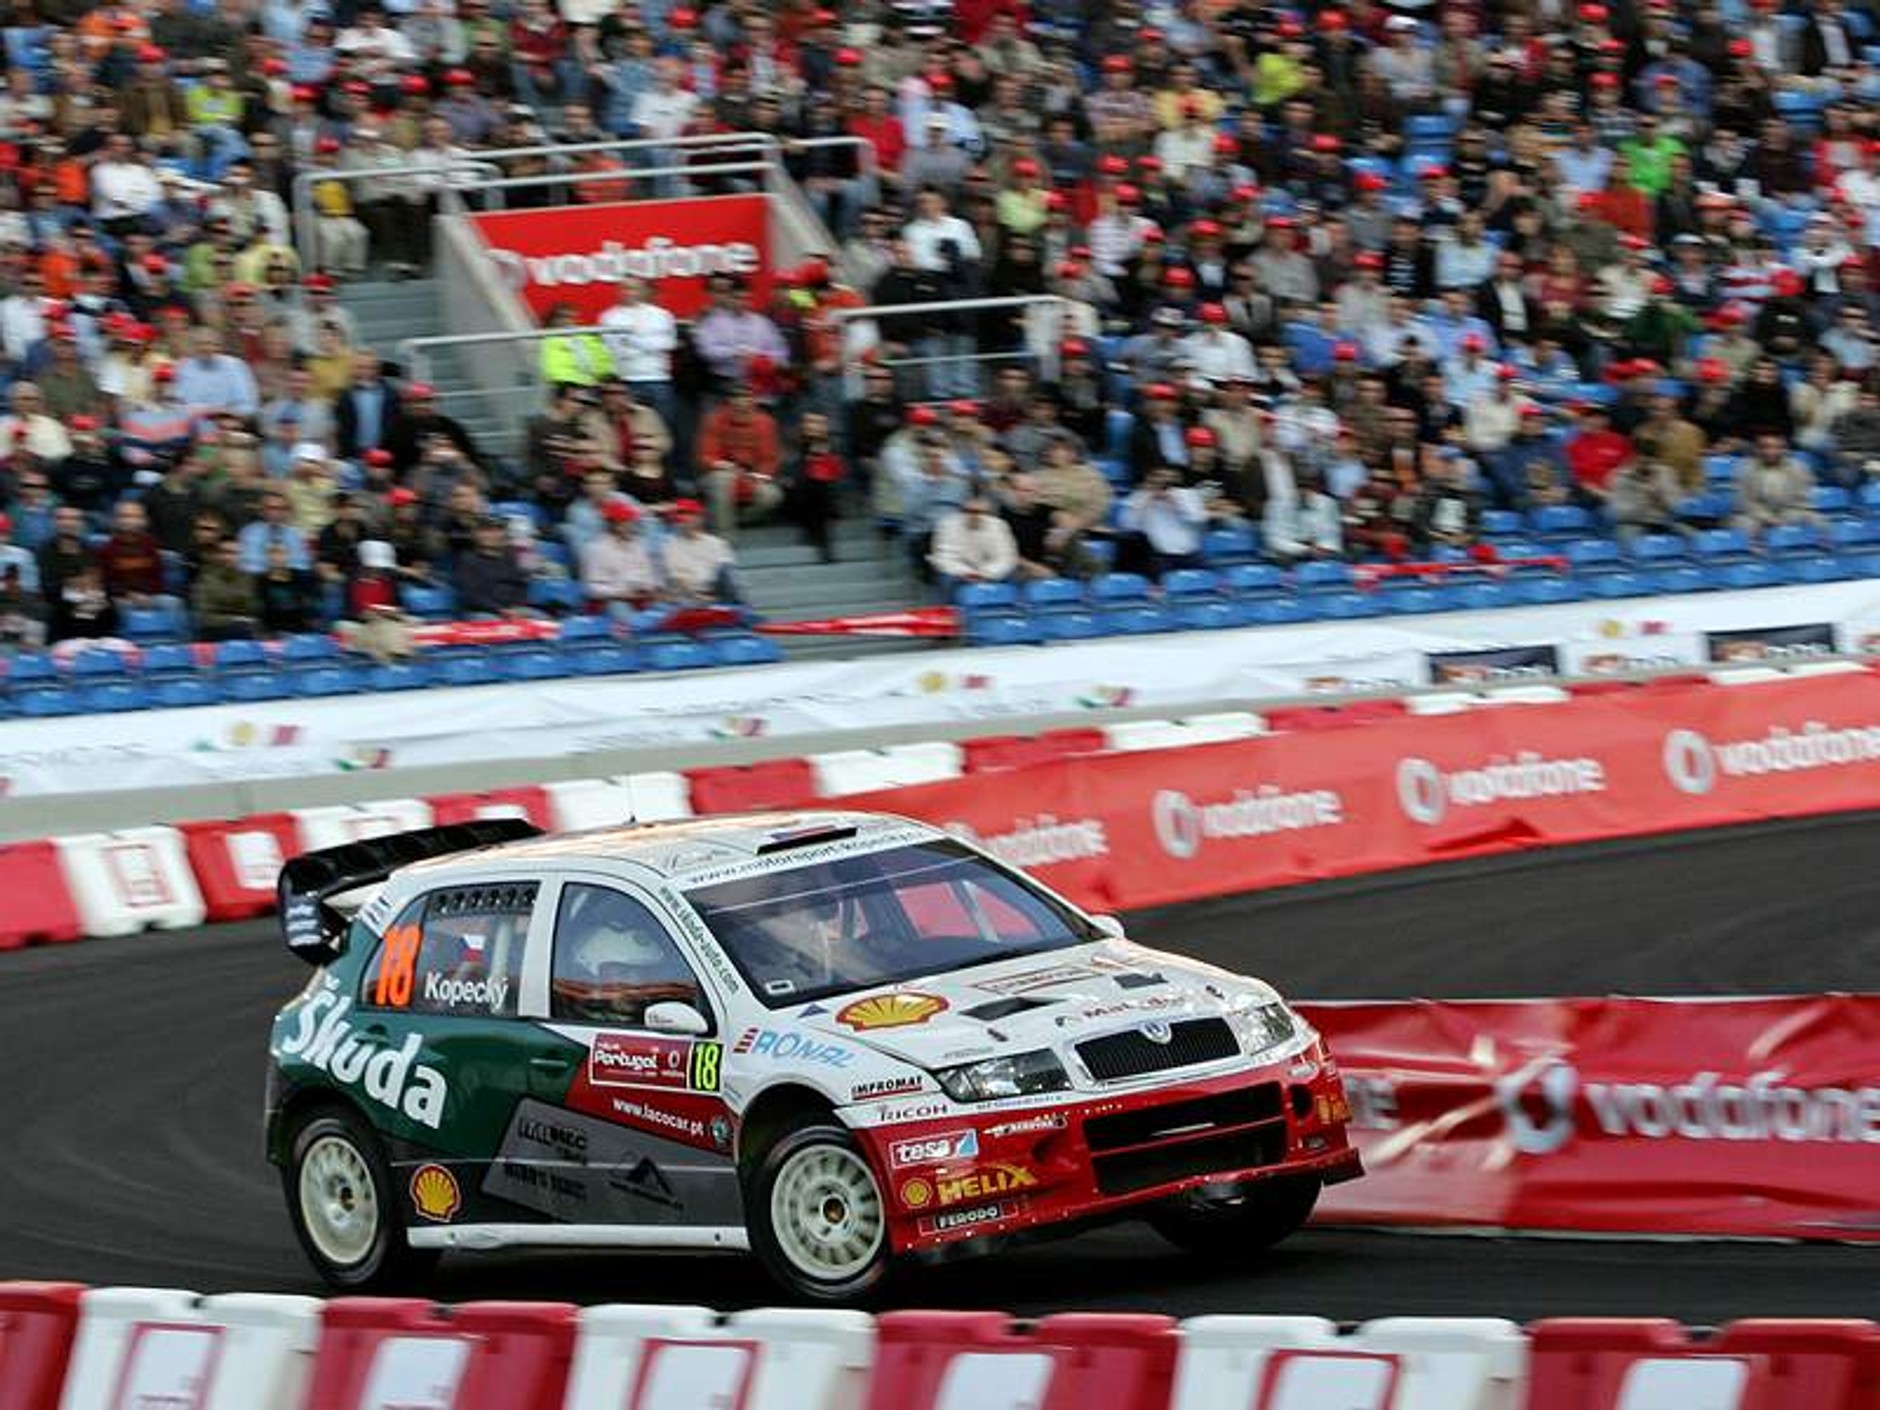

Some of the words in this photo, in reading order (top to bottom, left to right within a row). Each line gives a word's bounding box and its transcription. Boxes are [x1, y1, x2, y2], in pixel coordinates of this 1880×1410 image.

[525, 236, 761, 286] vodafone
[375, 922, 421, 1007] 18
[425, 971, 509, 1010] Kopecký
[594, 1049, 657, 1071] Portugal
[694, 1043, 720, 1091] 18
[753, 1030, 856, 1070] RONAL
[612, 1098, 705, 1137] www.lacocar.pt
[878, 1103, 949, 1121] RICOH
[896, 1140, 951, 1163] tesa
[937, 1163, 1039, 1205] HELIX
